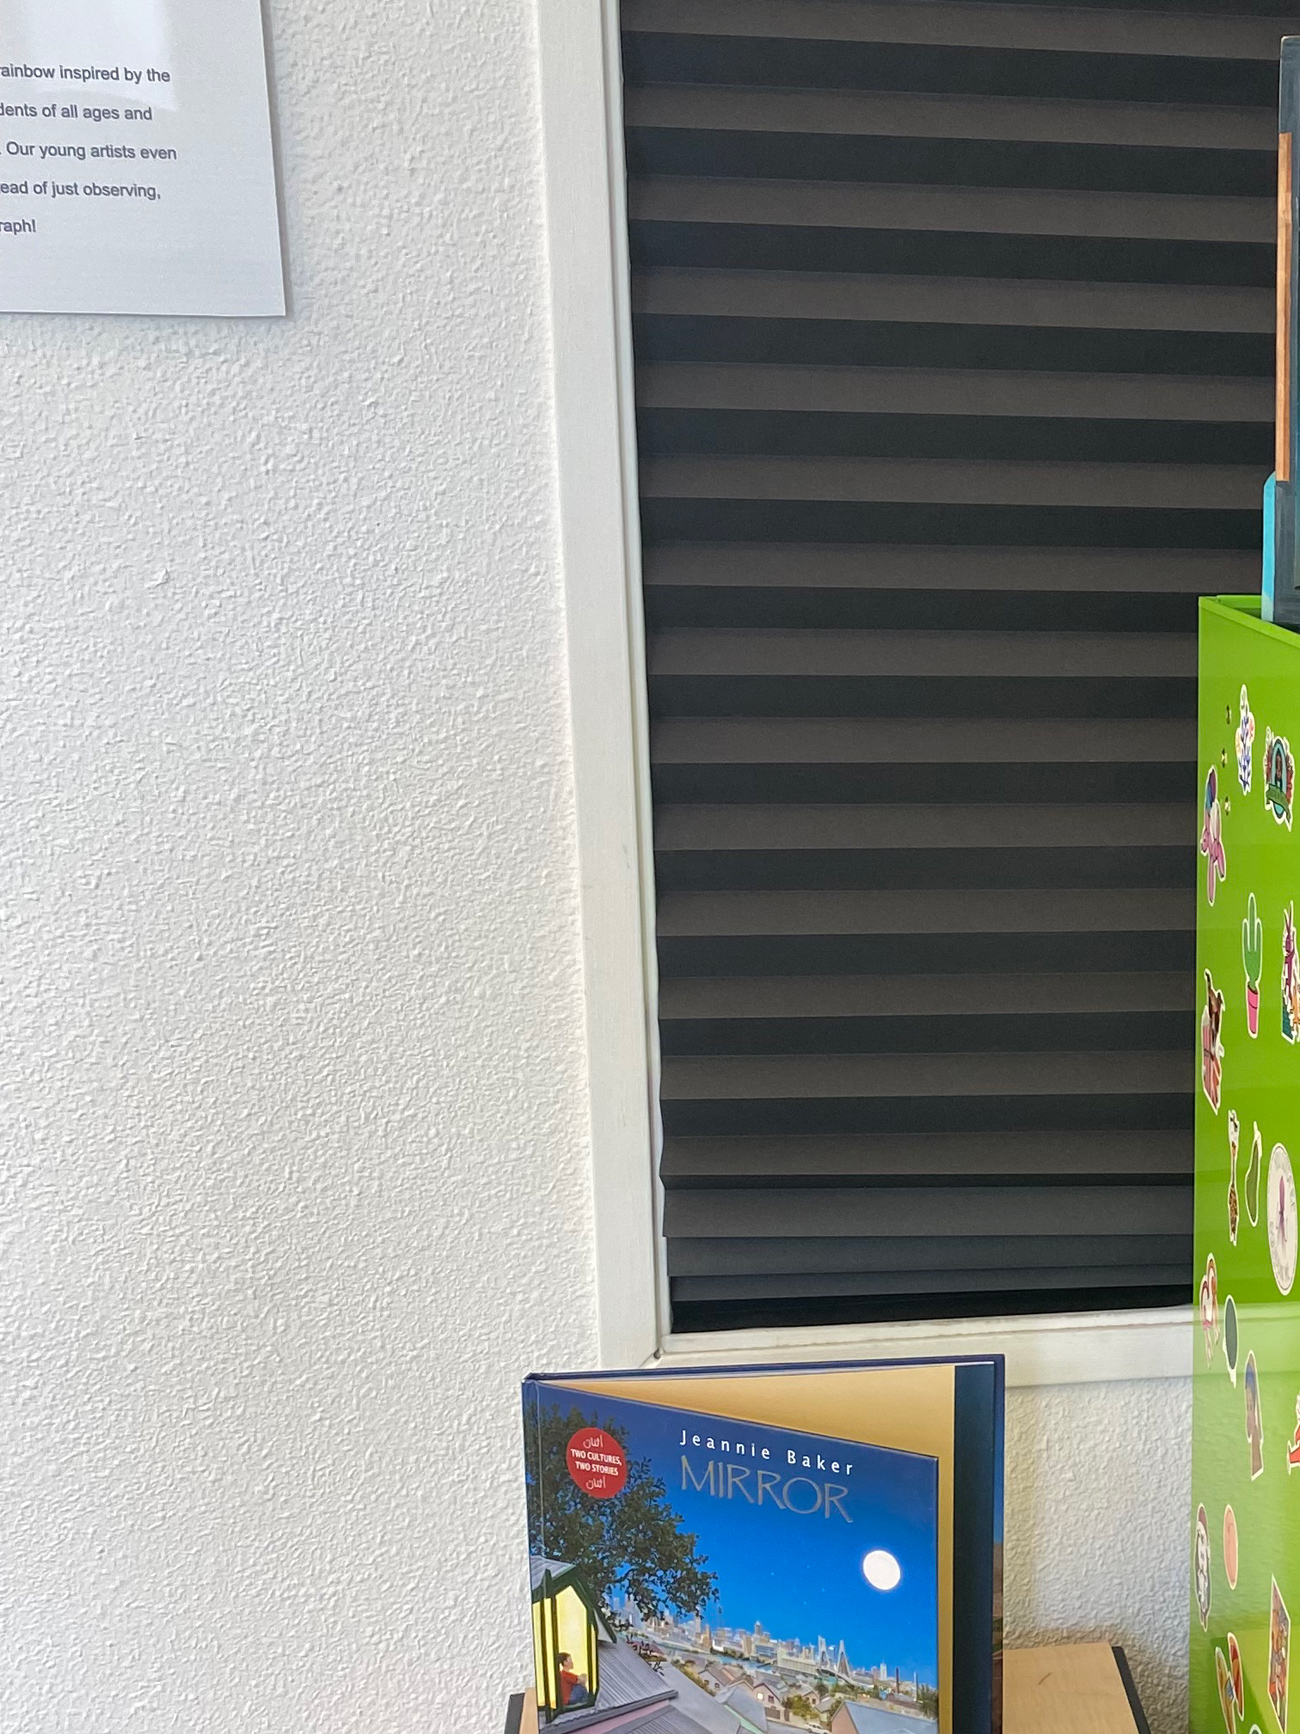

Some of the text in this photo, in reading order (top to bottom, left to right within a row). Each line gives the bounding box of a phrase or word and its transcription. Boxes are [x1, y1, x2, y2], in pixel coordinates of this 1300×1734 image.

[59, 64, 120, 83] inspired
[124, 67, 142, 84] by
[147, 68, 171, 83] the
[42, 104, 57, 118] of
[61, 104, 78, 119] all
[83, 107, 120, 122] ages
[124, 107, 153, 121] and
[6, 141, 177, 160] Our young artists even
[33, 181, 50, 195] of
[51, 181, 79, 199] just
[83, 182, 161, 201] observing,
[570, 1448, 622, 1466] TWO CULTURES,
[679, 1429, 853, 1475] Jeannie Baker
[575, 1461, 619, 1476] TWO STORIES
[681, 1454, 853, 1523] MIRROR
